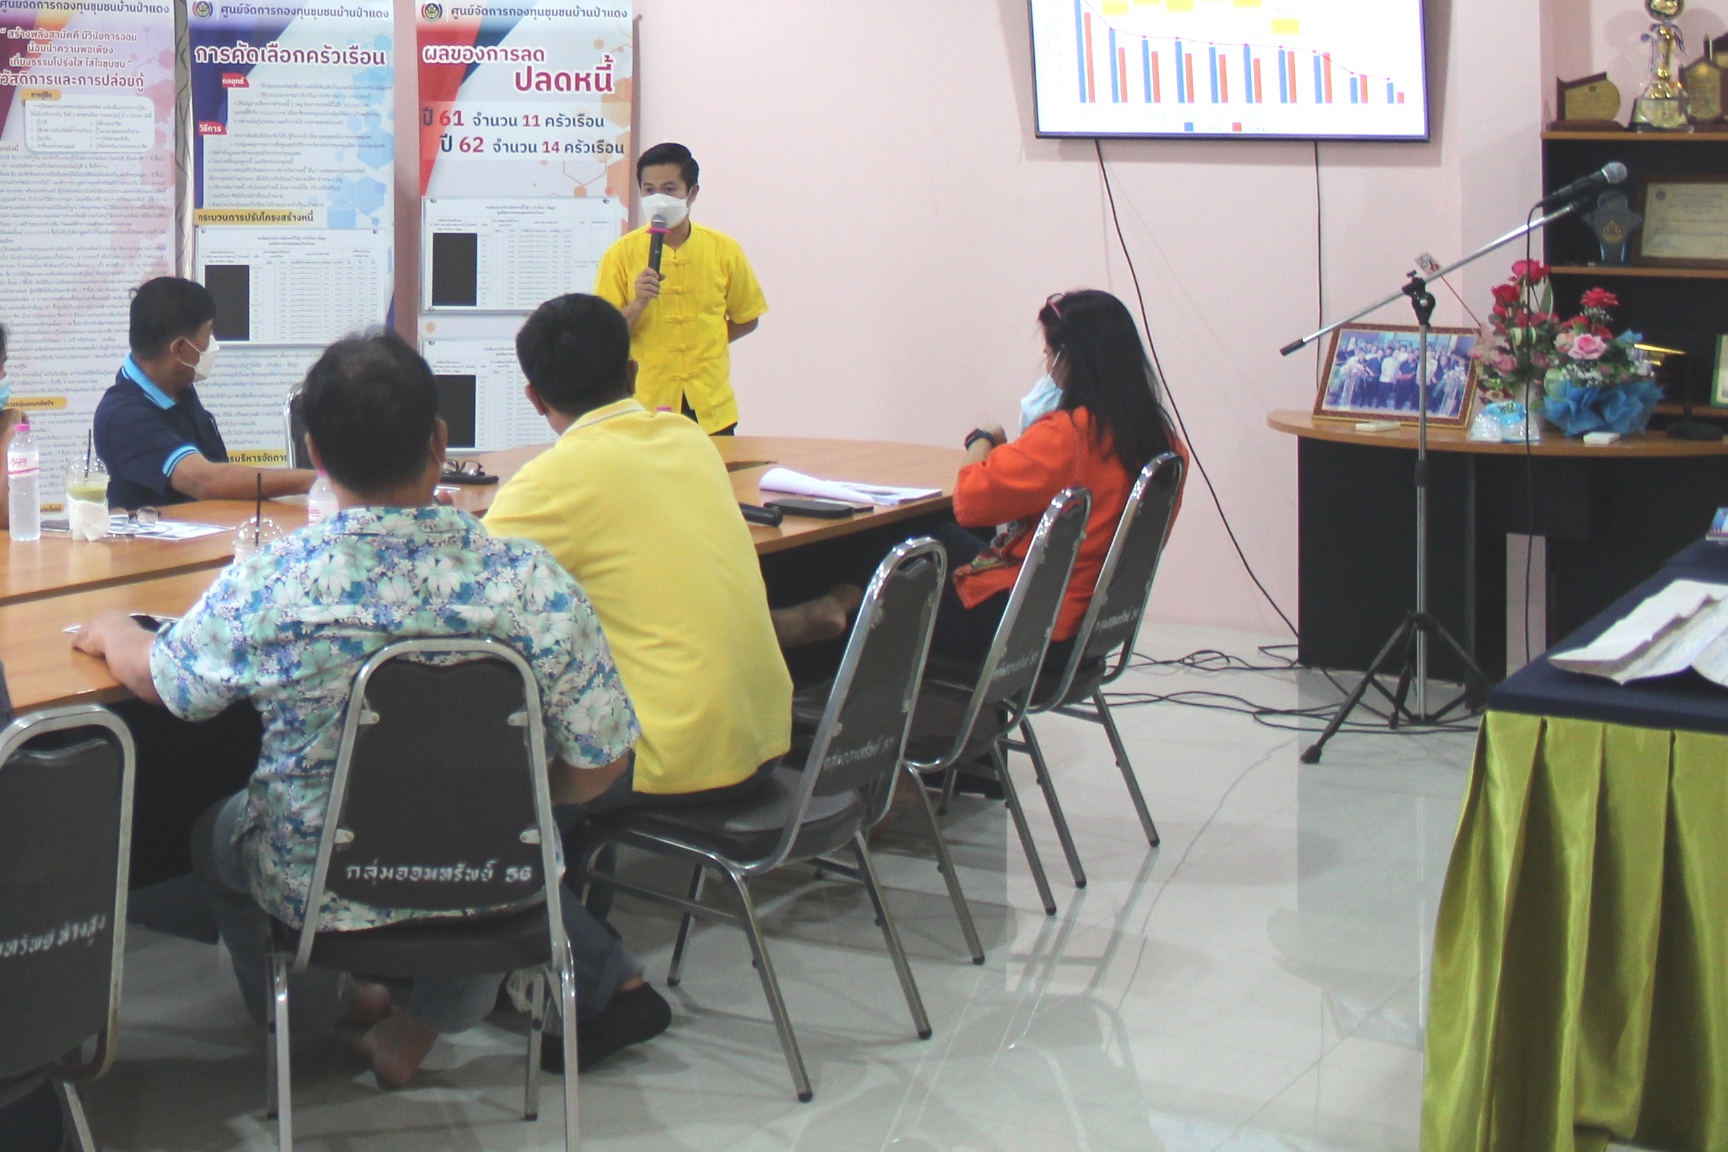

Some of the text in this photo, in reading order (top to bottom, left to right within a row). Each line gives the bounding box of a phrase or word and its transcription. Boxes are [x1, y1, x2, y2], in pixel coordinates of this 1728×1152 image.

[221, 3, 390, 20] ศูนย์จัดการกองทุนชุมชนบ้านป่าแดง
[451, 4, 628, 21] ศูนย์จัดการกองทุนชุมชนบ้านป่าแดง
[27, 43, 114, 55] น้อมนำความพอเพียง
[195, 41, 386, 65] การคัดเลือกครัวเรือน
[424, 46, 546, 63] ผลของการลด
[514, 54, 614, 94] ปลดหนี้
[422, 106, 605, 128] ปี 61 จำนวน 11 ครัวเรือน
[440, 133, 625, 155] ปี 62 จำนวน 14 ครัวเรือน
[198, 209, 314, 222] กระบวนการปรับโครงสร้างหนี้
[345, 858, 532, 886] กลุ่มออมทรัพย์ 56
